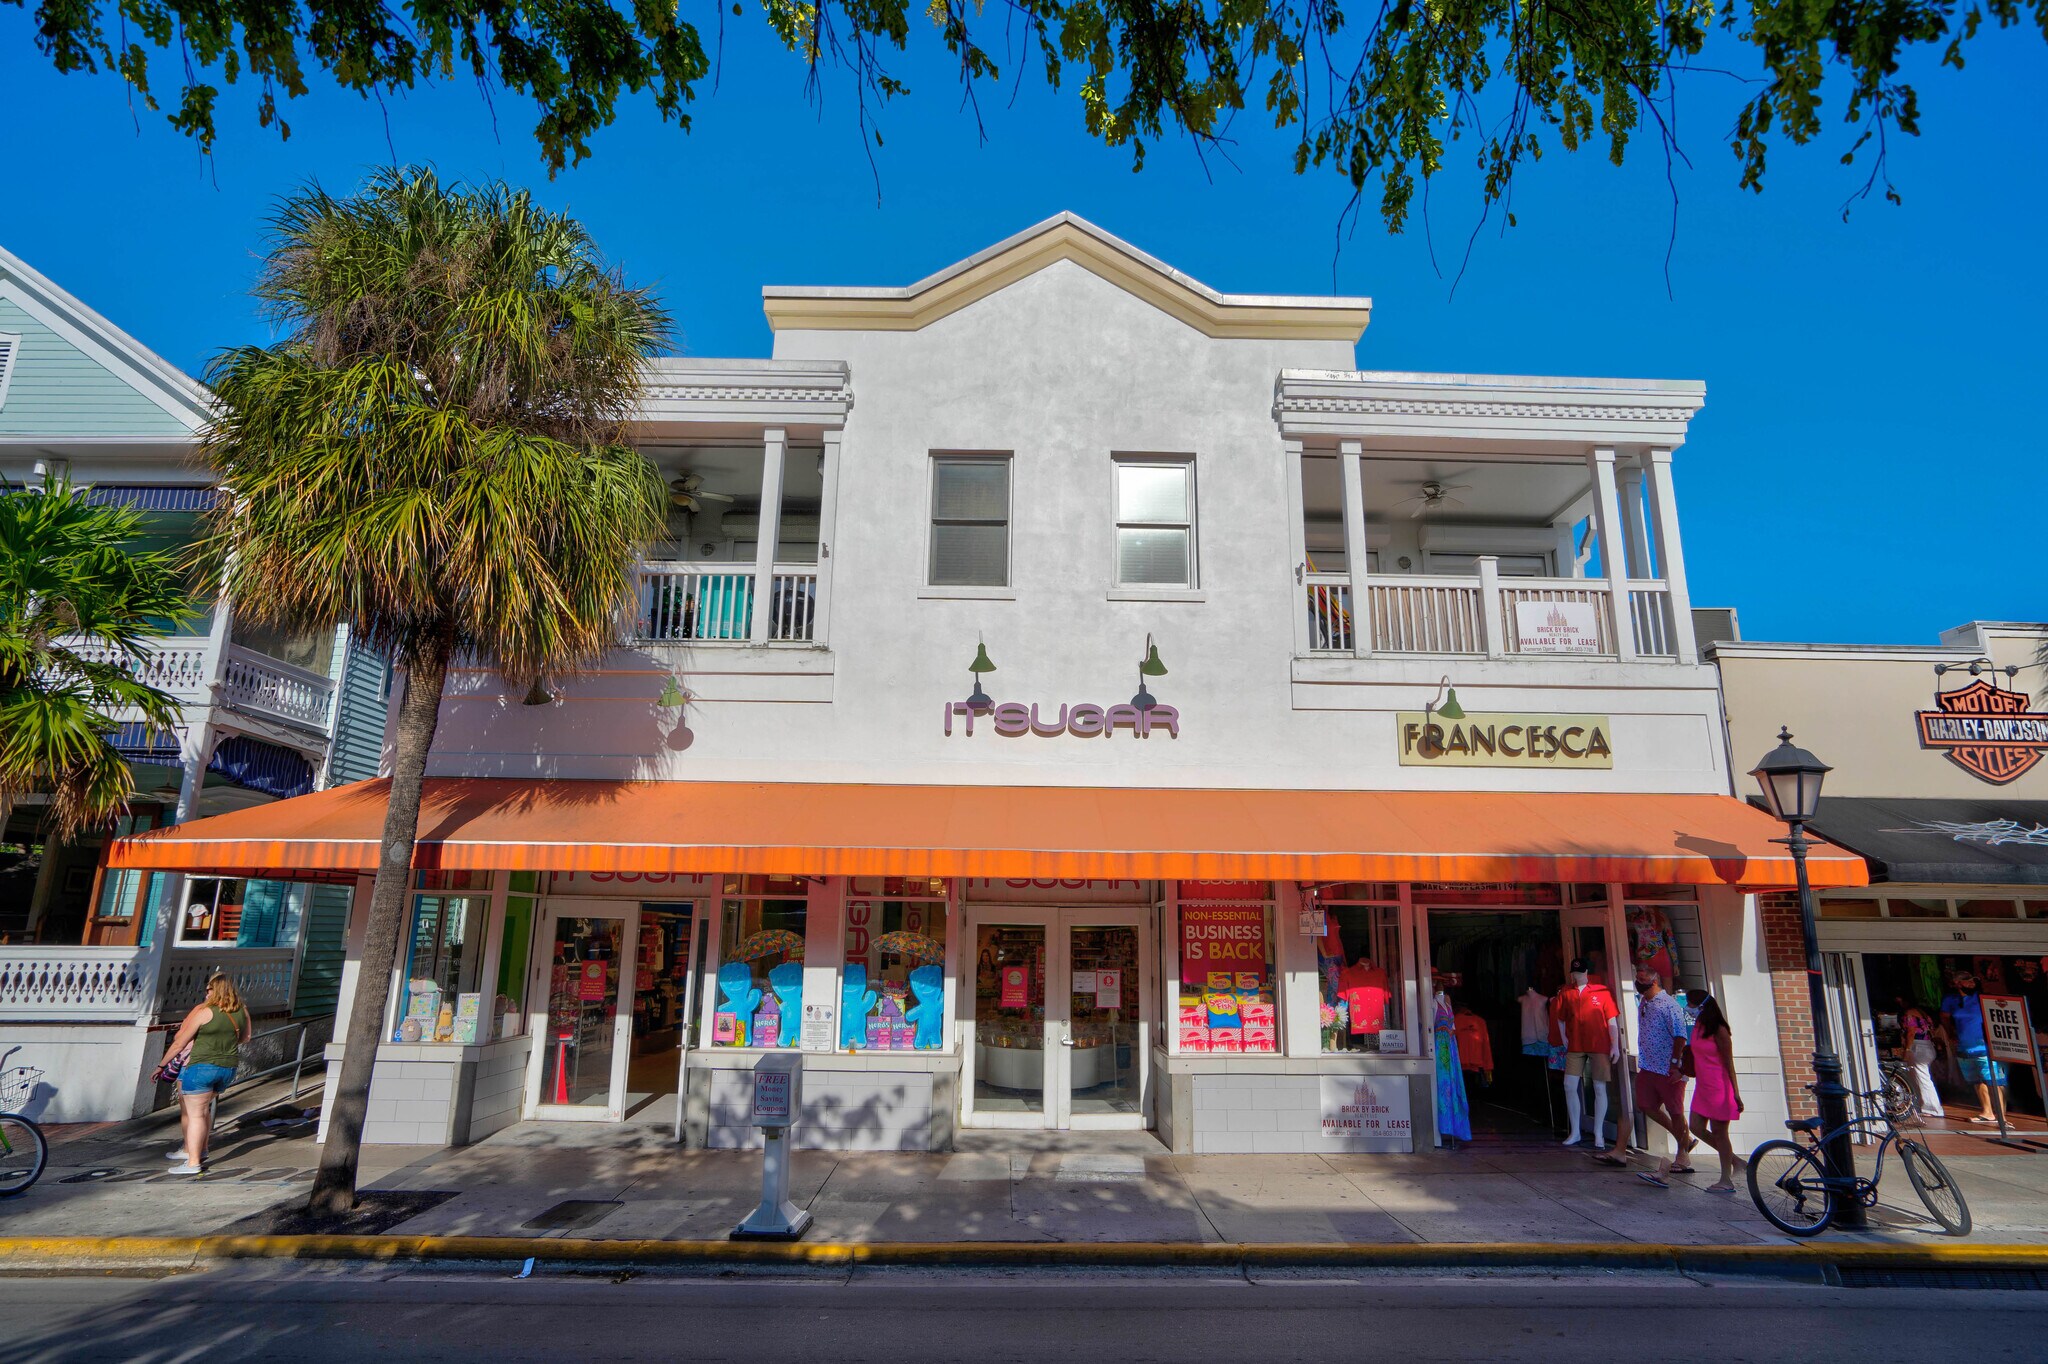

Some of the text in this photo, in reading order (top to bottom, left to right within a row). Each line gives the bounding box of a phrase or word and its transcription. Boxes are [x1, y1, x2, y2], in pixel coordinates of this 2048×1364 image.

[1520, 638, 1556, 646] AVAILABLE
[1578, 638, 1597, 646] LEASE
[1952, 688, 2018, 713] MOTOR
[1404, 723, 1611, 760] FRANCESCA
[1961, 747, 2028, 775] CYCLES
[1185, 911, 1261, 920] NON-ESSENTIAL
[1186, 925, 1262, 939] BUSINESS
[1952, 932, 1967, 940] 121
[1186, 942, 1263, 959] IS BACK
[1989, 1008, 2019, 1024] FREE
[1993, 1024, 2019, 1040] GIFT
[758, 1075, 787, 1084] FREE
[760, 1085, 783, 1093] Money
[760, 1095, 784, 1103] Saving
[756, 1104, 786, 1113] Coupons
[1341, 1105, 1390, 1113] BRICK BY BRICK
[1322, 1119, 1410, 1128] AVAILABLE FOR LEASE
